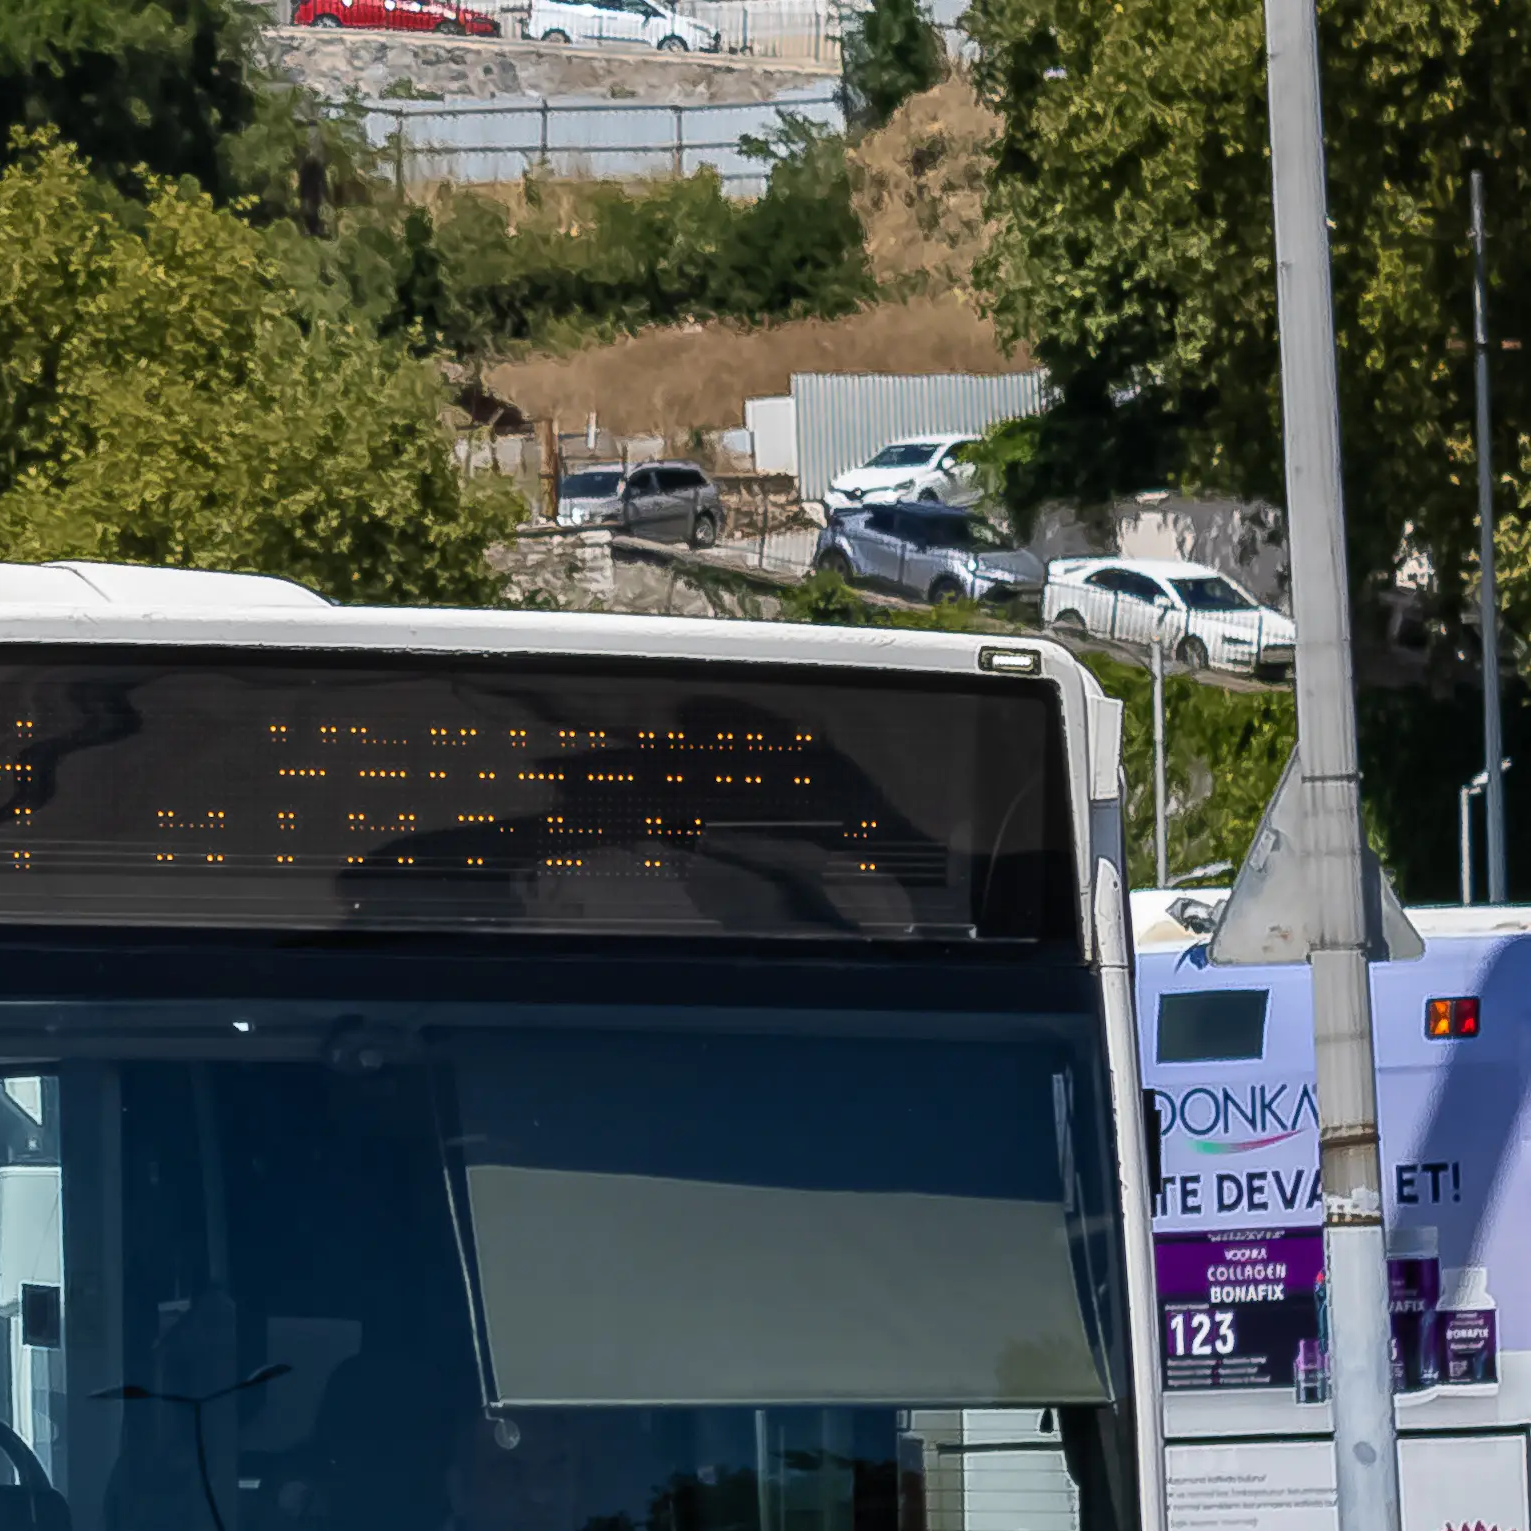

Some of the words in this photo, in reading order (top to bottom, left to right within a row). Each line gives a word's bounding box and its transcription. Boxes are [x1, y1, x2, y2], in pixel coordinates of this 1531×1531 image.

[1396, 1162, 1460, 1204] ET!
[1208, 1264, 1286, 1281] COLLAGEN
[1211, 1283, 1284, 1303] BONAFIX
[1171, 1311, 1235, 1355] 123
